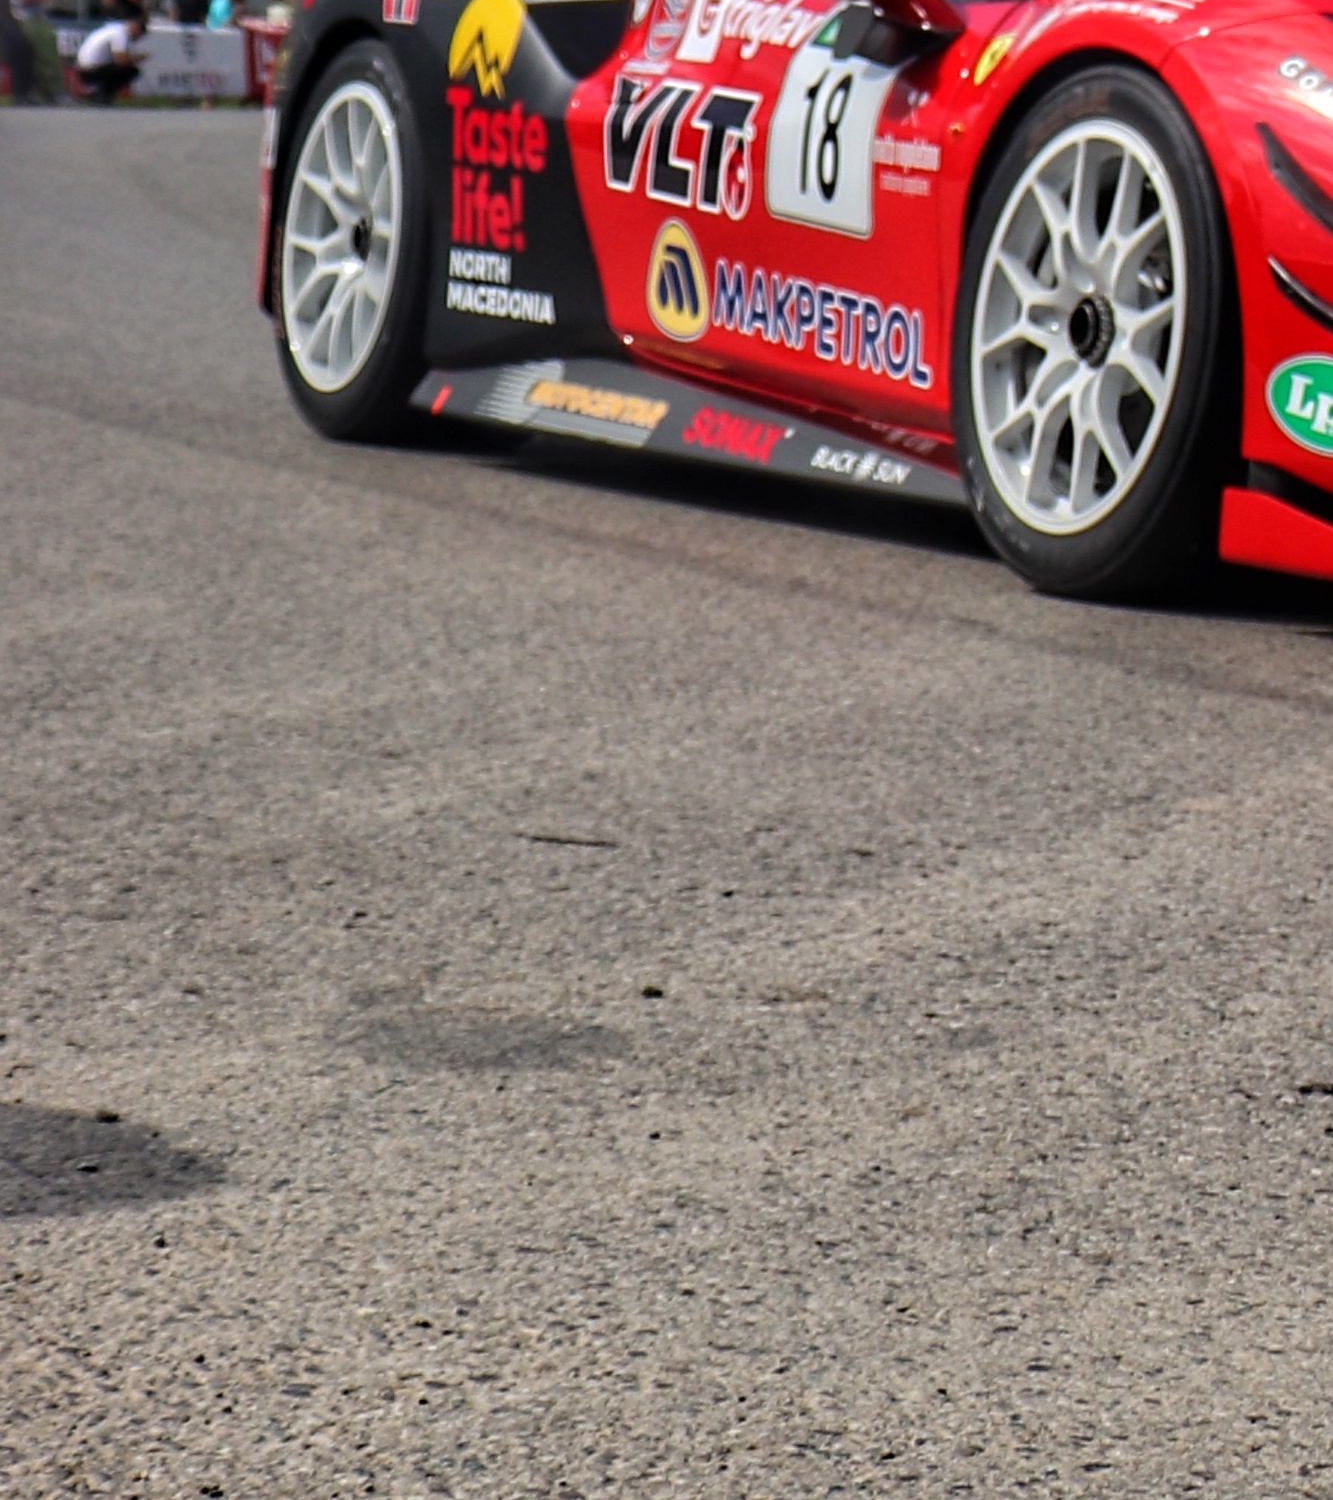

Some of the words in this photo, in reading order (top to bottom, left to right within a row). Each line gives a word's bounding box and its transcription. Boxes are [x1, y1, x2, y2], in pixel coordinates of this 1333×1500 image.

[446, 86, 548, 173] Taste
[603, 73, 763, 214] VLT
[806, 69, 853, 204] 18
[451, 165, 526, 253] life!
[446, 279, 557, 325] MACEDONIA
[449, 247, 512, 285] NORTH
[711, 257, 933, 390] MAKPETROL
[682, 405, 786, 466] SONAX
[810, 444, 857, 474] BLACK
[872, 456, 914, 485] SUN
